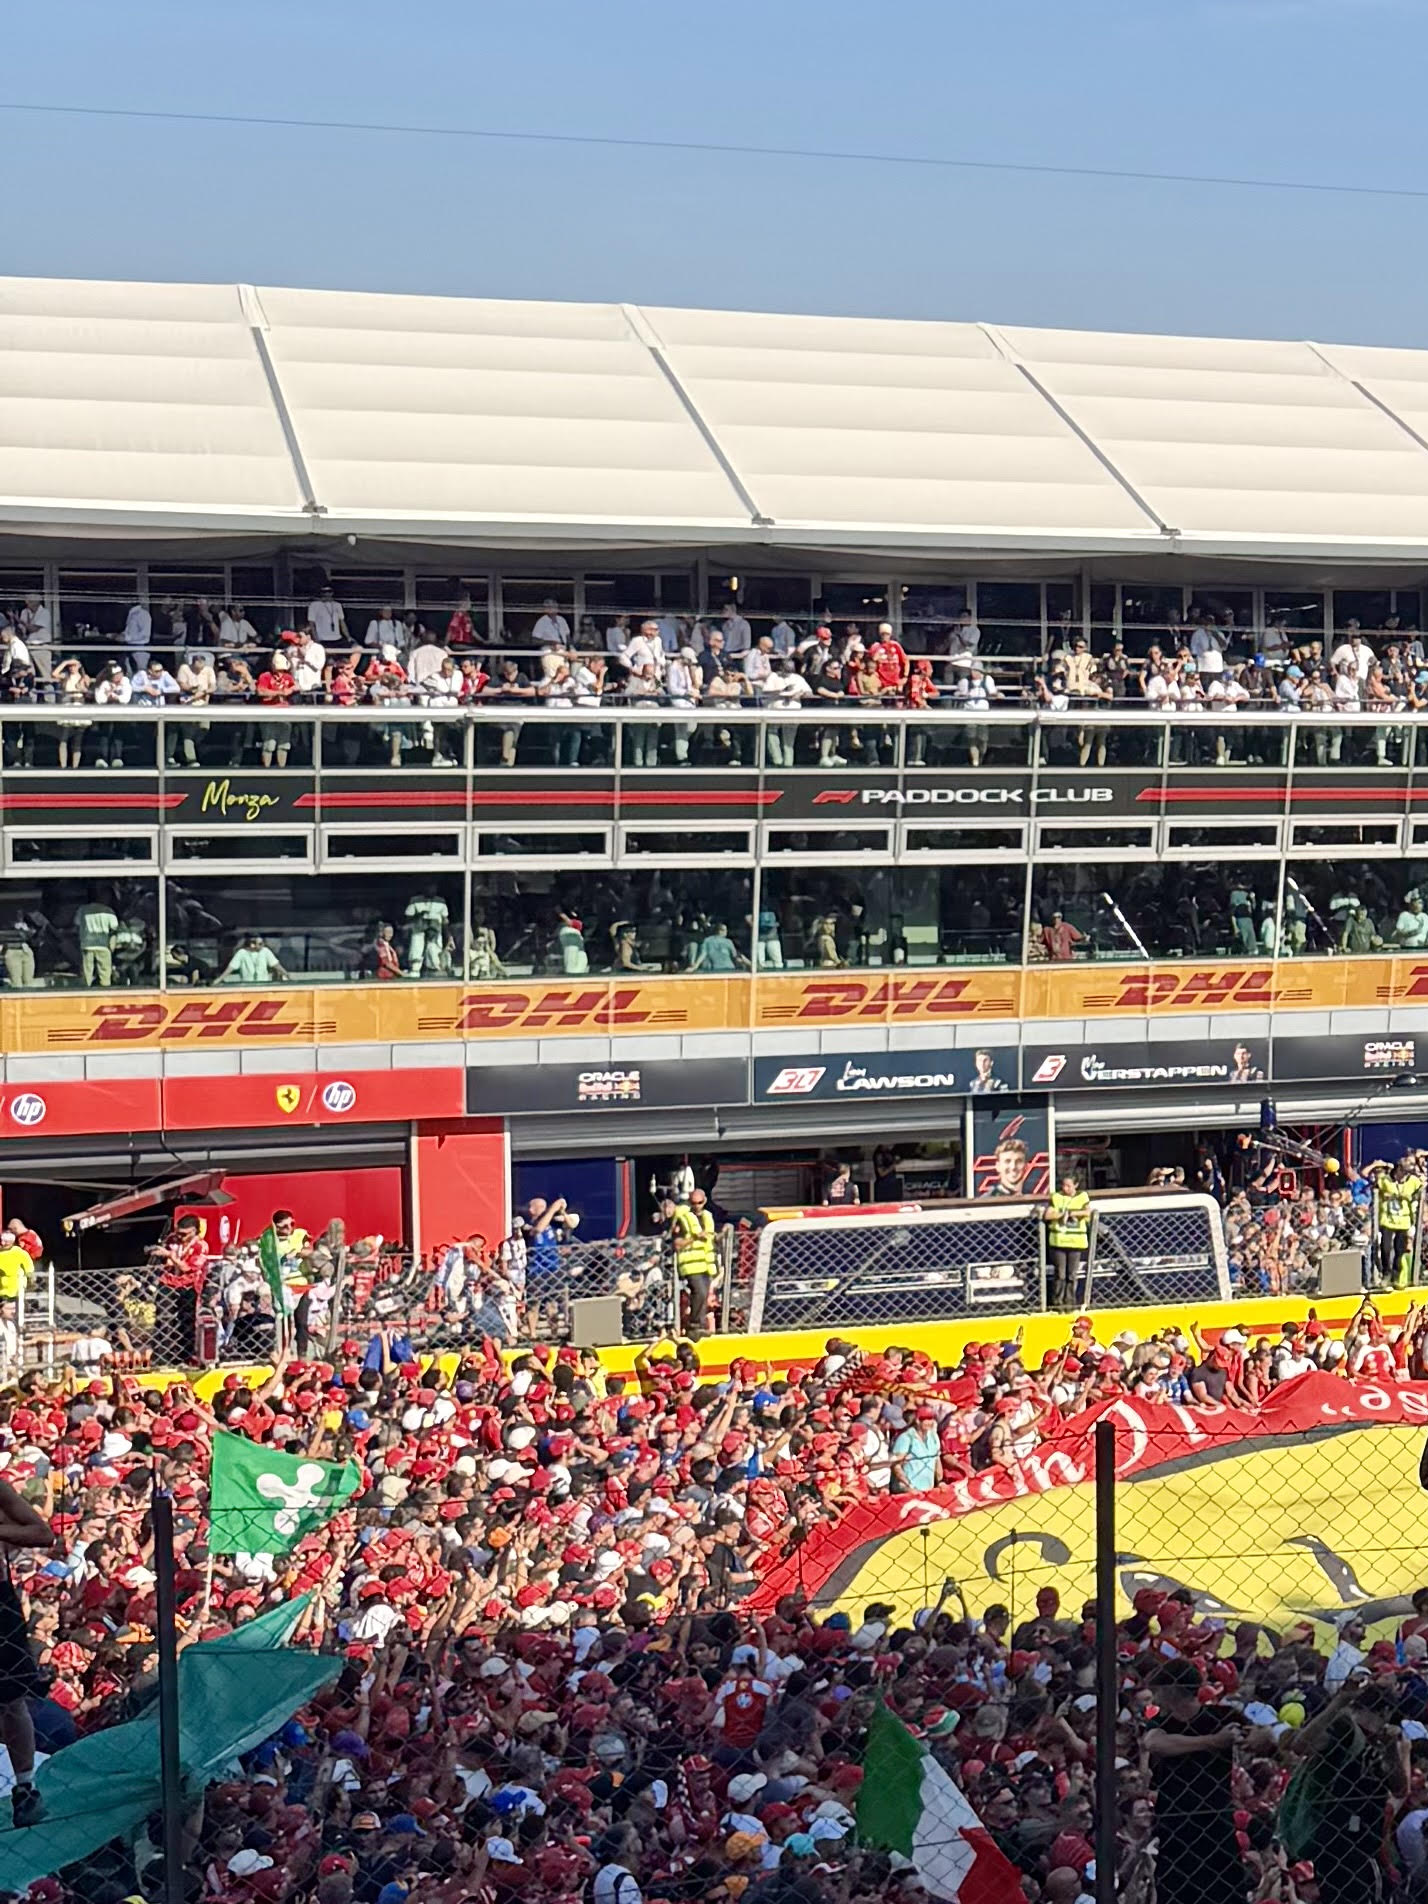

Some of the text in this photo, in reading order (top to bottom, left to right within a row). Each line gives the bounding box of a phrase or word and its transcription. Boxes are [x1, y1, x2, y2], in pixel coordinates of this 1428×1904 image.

[201, 778, 280, 821] Monza
[861, 788, 1024, 804] PADDOCK
[1029, 787, 1113, 803] CLUB
[797, 979, 981, 1017] DHL
[1114, 970, 1283, 1007] DHL
[89, 1000, 299, 1041] DHL
[455, 989, 652, 1029] DHL
[1364, 1040, 1415, 1052] ORACLE
[578, 1070, 641, 1082] ORACLE
[837, 1074, 954, 1092] LAWSON
[1044, 1056, 1063, 1080] 3
[1082, 1064, 1228, 1082] VERSTAPPEN
[14, 1094, 43, 1126] hp
[326, 1081, 352, 1112] hp
